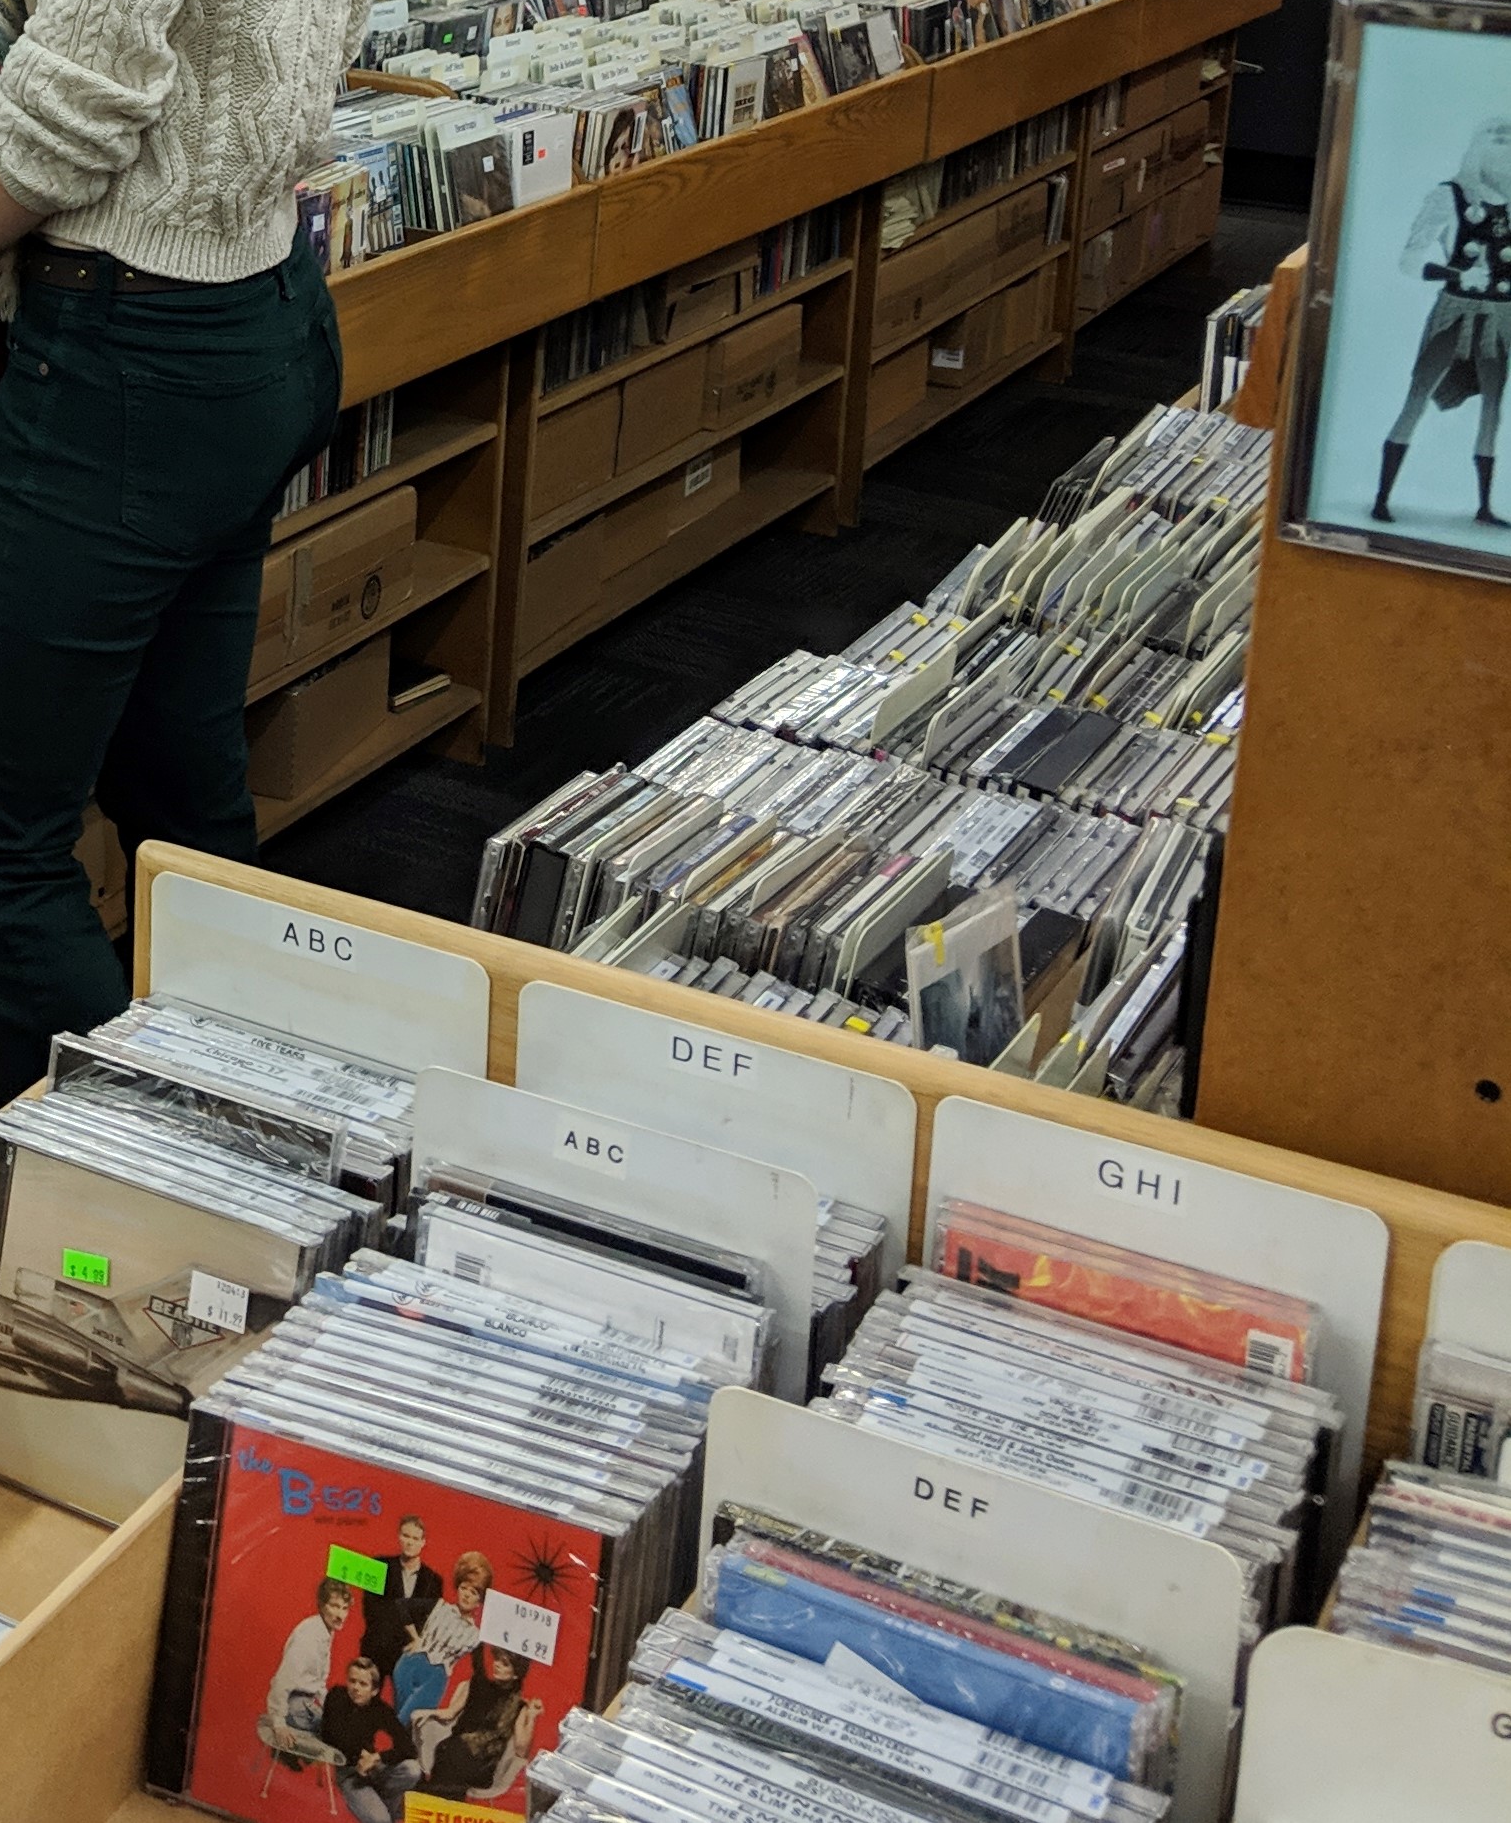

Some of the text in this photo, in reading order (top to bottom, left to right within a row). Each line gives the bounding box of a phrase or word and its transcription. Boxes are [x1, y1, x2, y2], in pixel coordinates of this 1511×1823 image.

[282, 920, 355, 963] ABC
[206, 1047, 254, 1066] Chicago
[671, 1034, 757, 1080] DEF
[563, 1127, 627, 1165] ABC
[1097, 1158, 1184, 1207] GHI
[483, 1319, 527, 1338] BLANCO
[236, 1446, 273, 1475] the
[277, 1467, 383, 1516] B-52's
[913, 1474, 991, 1521] DEF
[713, 1773, 788, 1811] THE SLIM
